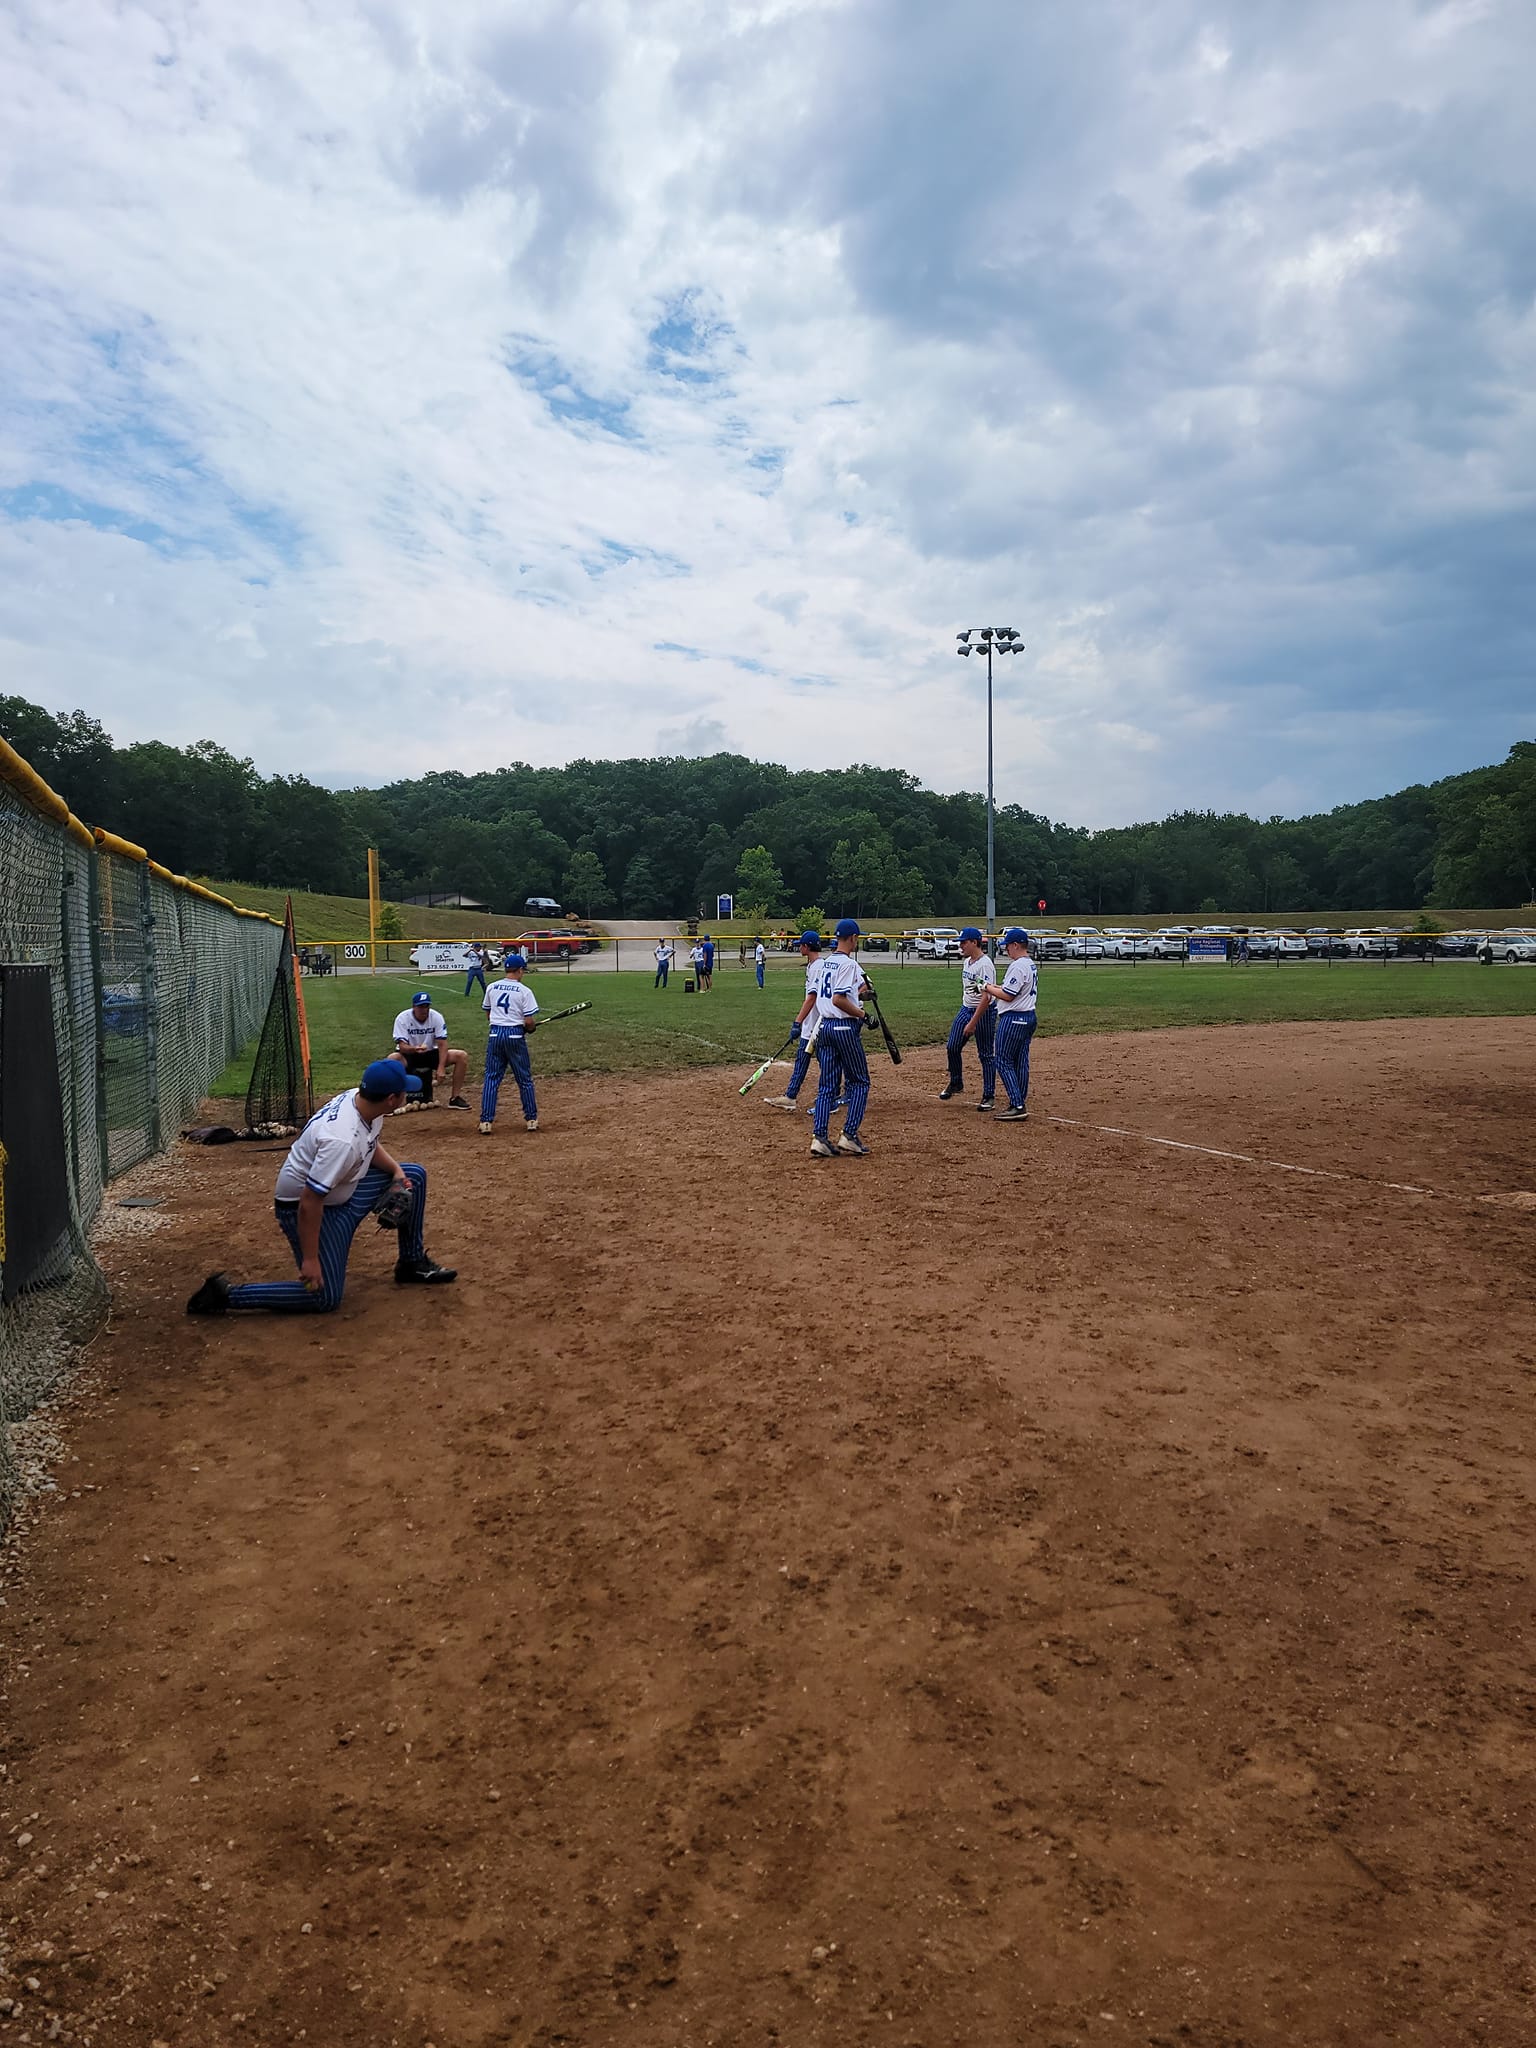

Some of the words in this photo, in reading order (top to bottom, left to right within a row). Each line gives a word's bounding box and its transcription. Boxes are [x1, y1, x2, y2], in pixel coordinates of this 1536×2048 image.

[345, 945, 366, 957] 300
[494, 984, 520, 992] WEIGEL
[497, 993, 510, 1014] 4
